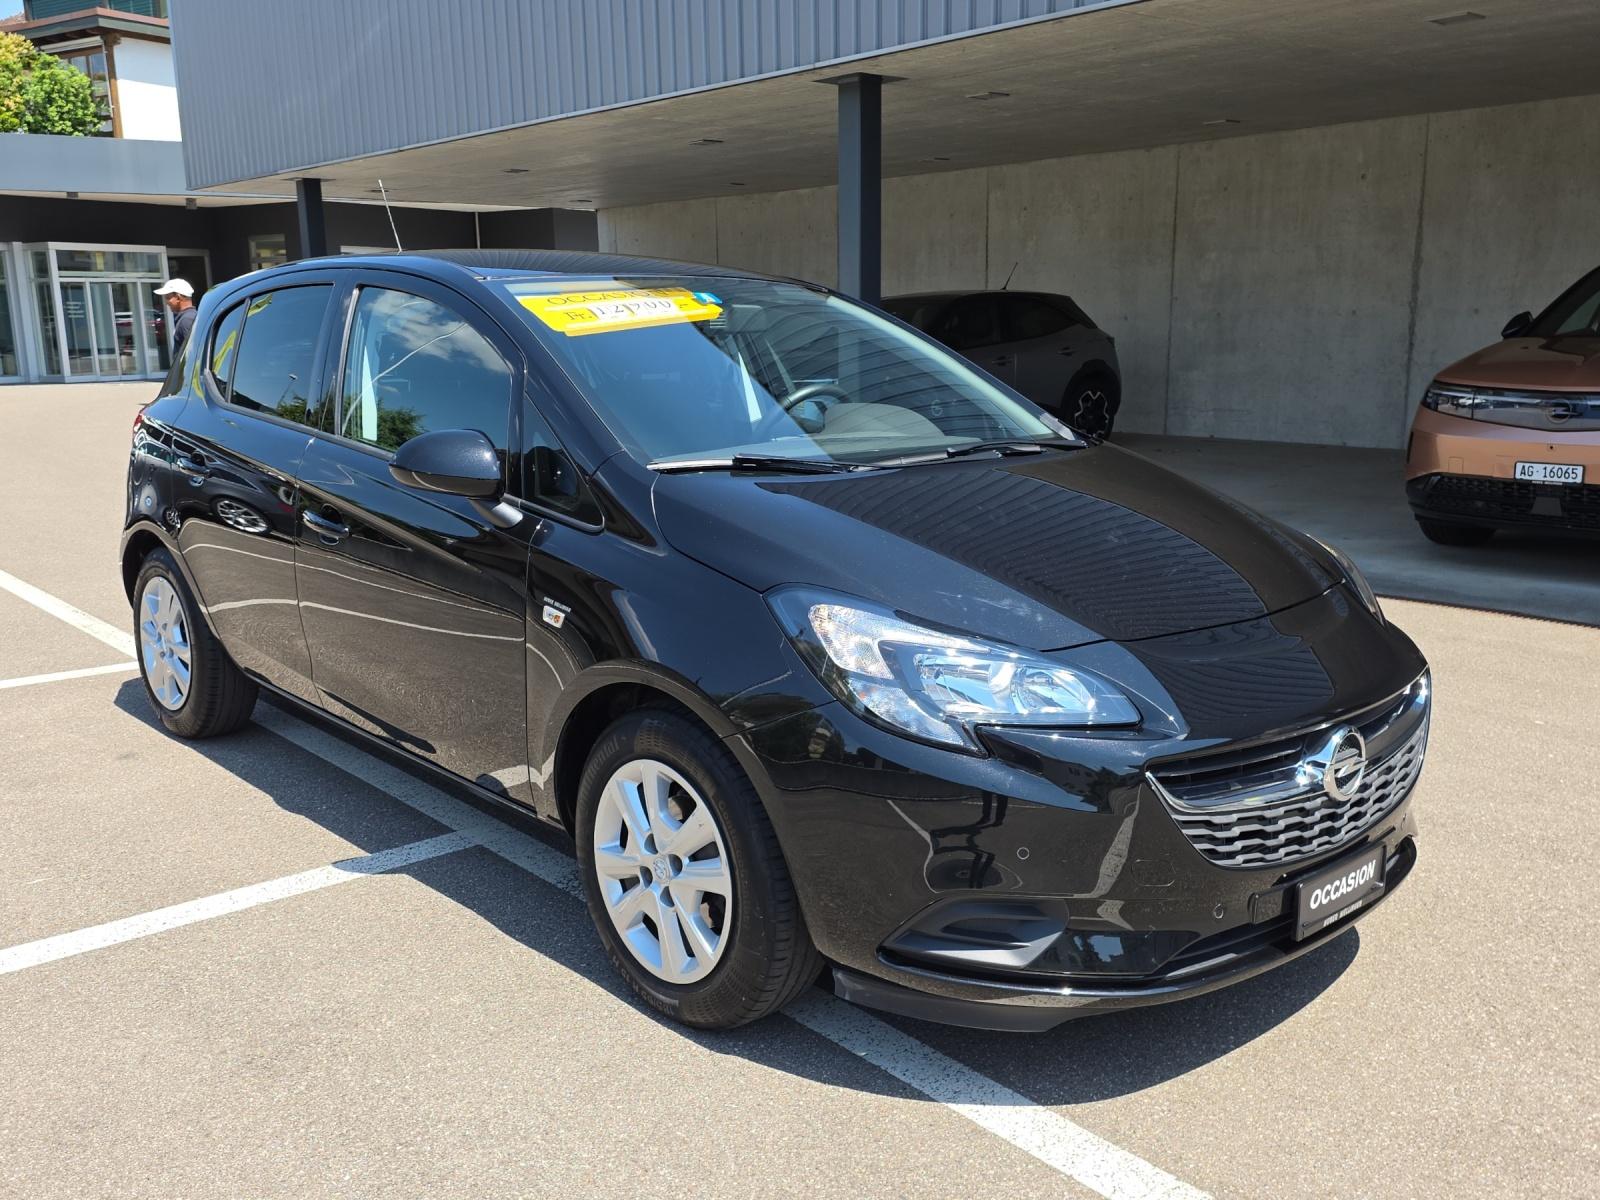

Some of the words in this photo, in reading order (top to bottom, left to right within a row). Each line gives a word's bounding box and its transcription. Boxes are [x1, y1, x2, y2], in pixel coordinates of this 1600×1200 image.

[1519, 464, 1534, 477] AG
[1542, 466, 1578, 480] 16065
[1310, 859, 1376, 910] OCCASION
